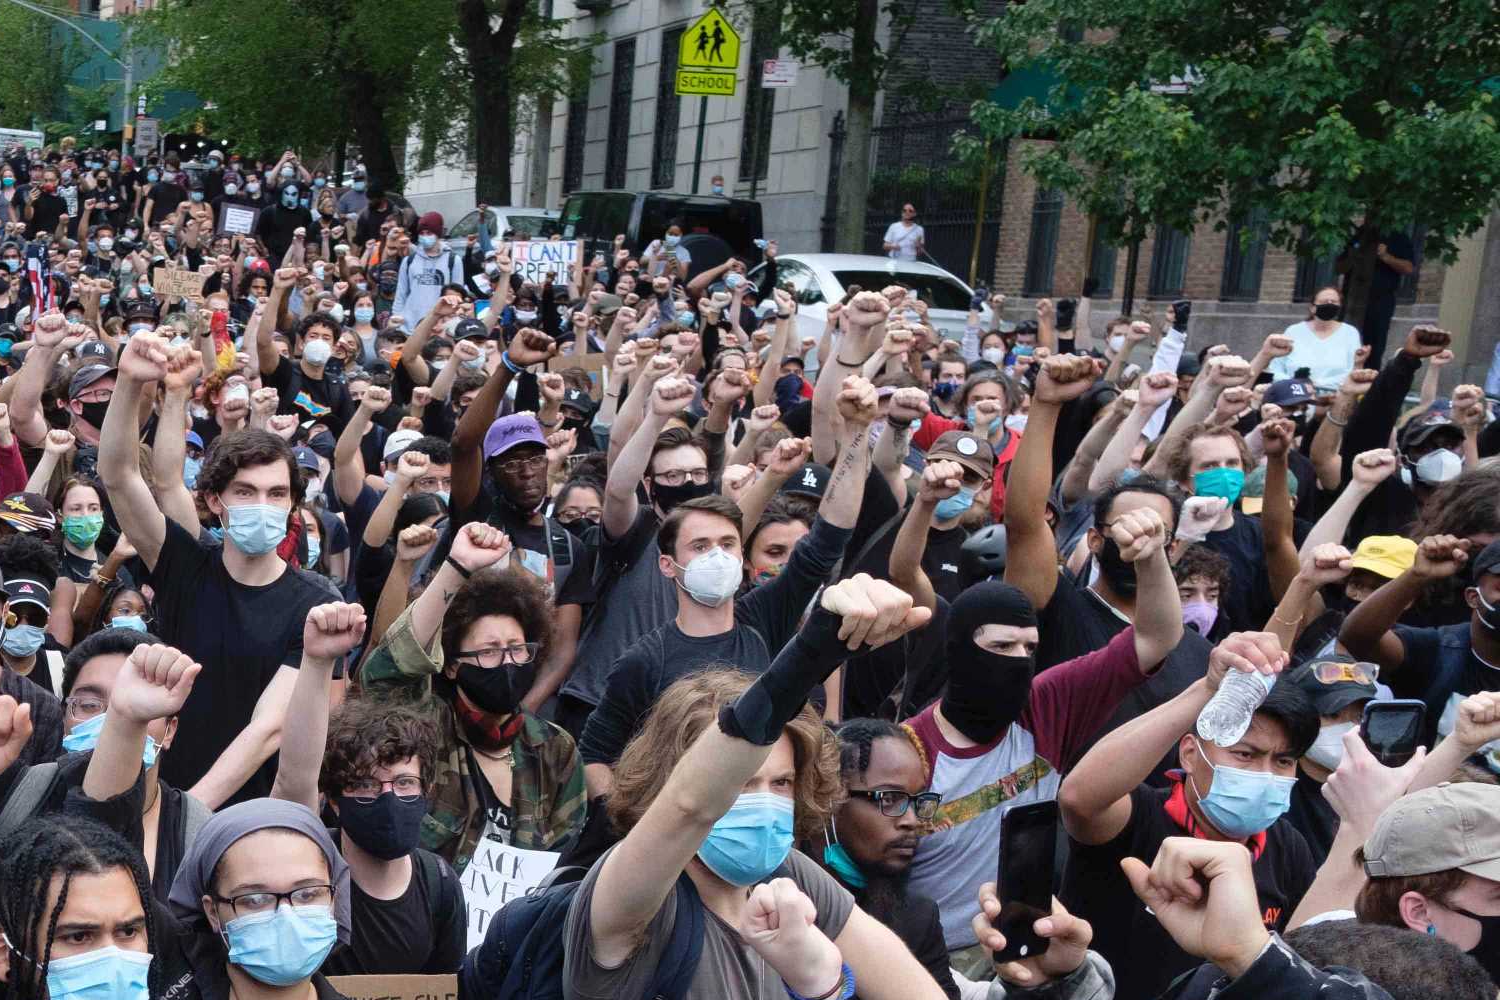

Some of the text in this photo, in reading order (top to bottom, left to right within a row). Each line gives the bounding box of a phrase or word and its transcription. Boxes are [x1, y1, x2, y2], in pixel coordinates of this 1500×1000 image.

[681, 76, 732, 90] SCHOOL
[516, 243, 527, 261] I
[802, 468, 818, 488] LA
